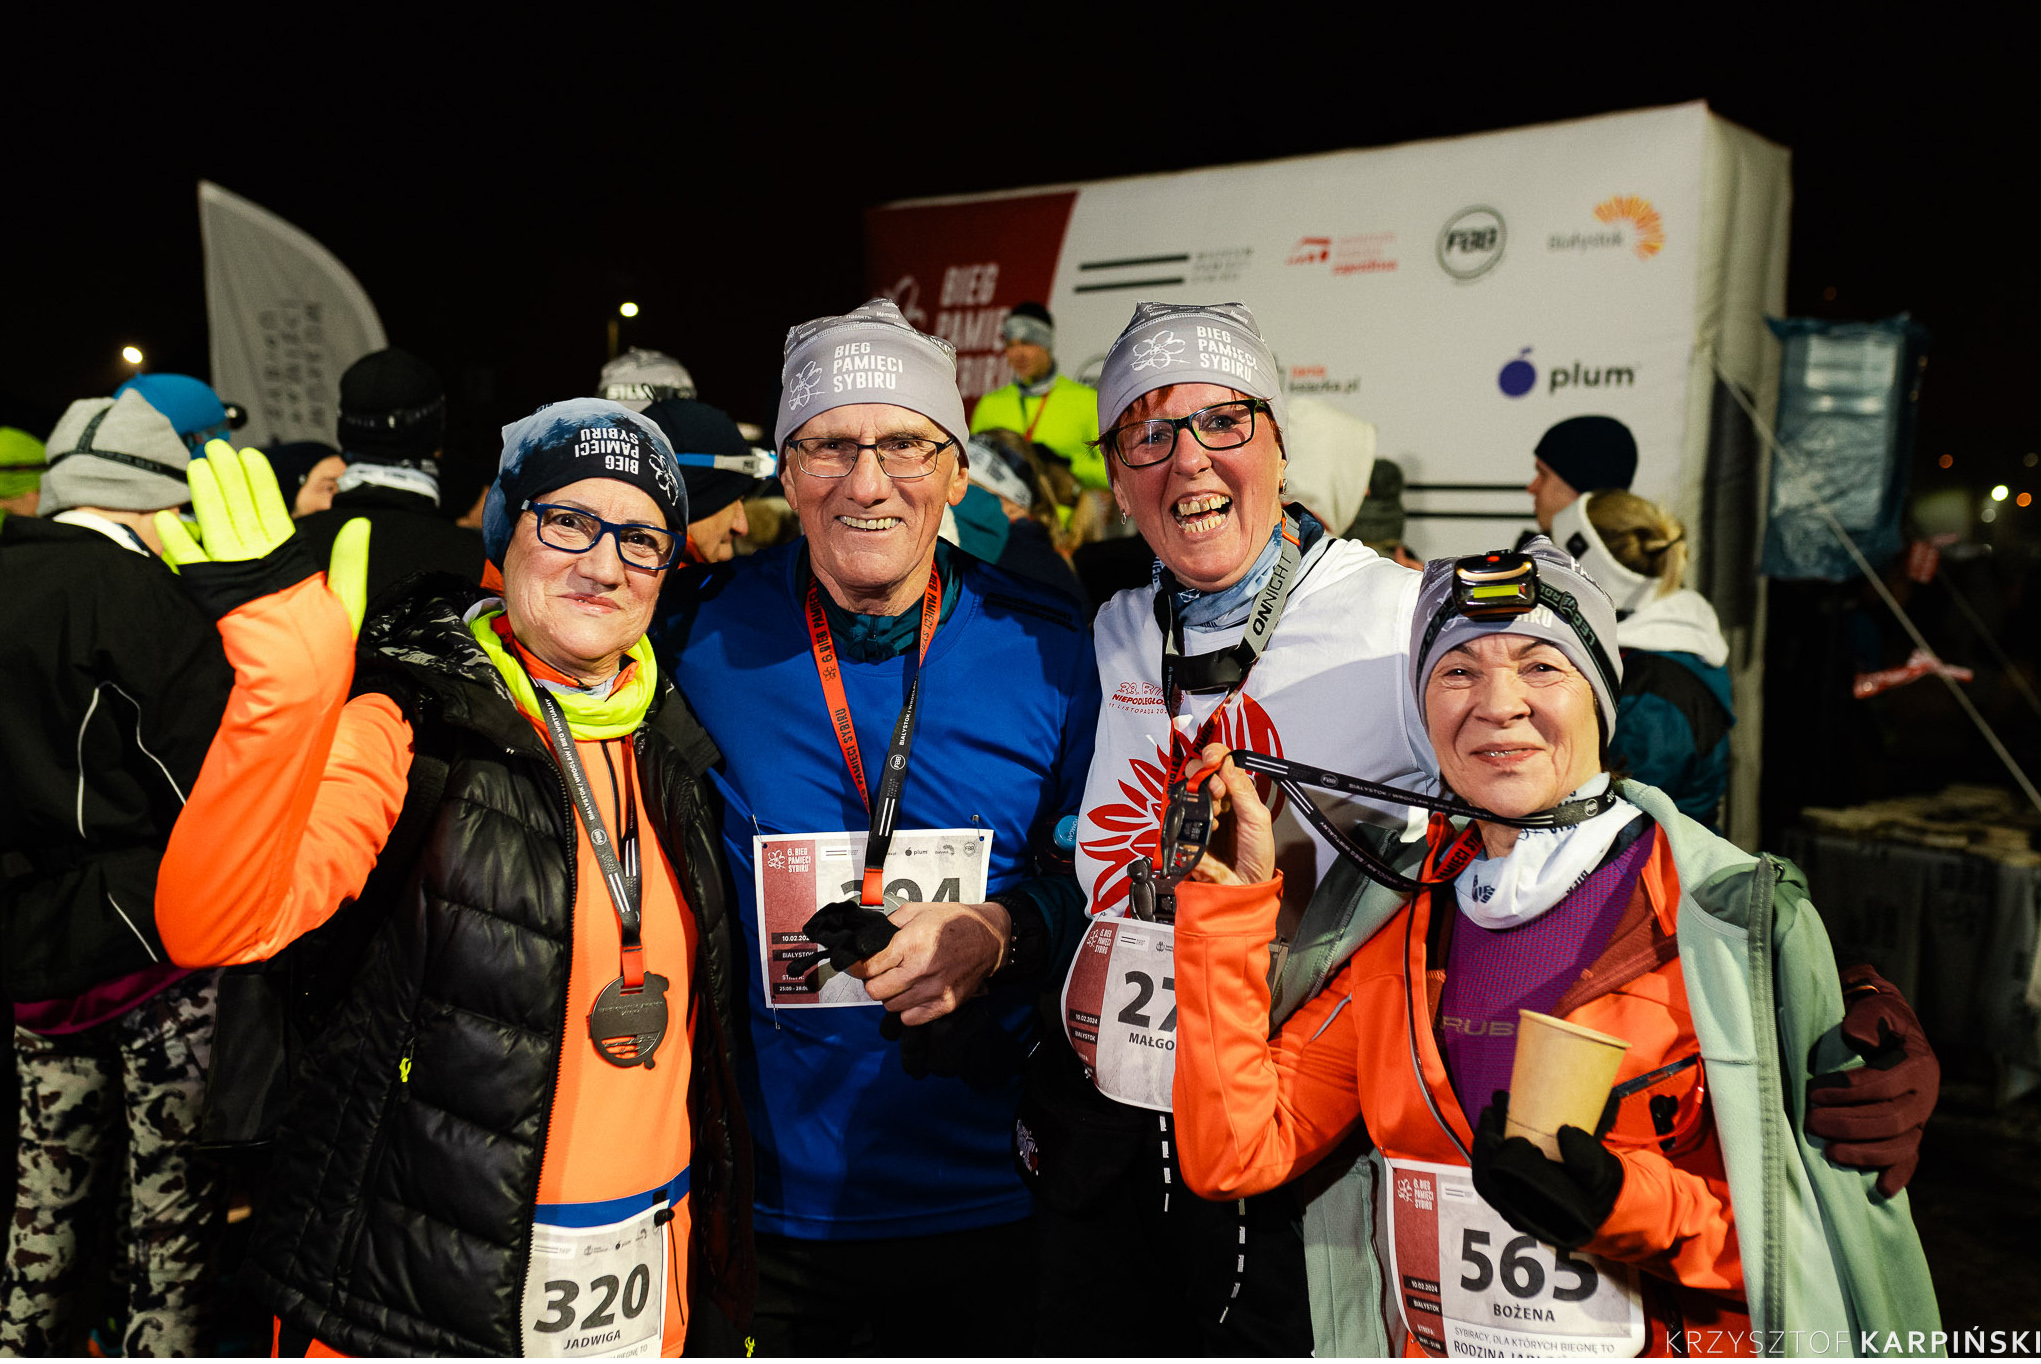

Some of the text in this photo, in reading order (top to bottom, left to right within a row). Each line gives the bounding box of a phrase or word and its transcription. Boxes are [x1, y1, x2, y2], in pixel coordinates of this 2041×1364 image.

[940, 264, 998, 307] BIEG
[1196, 325, 1232, 343] BIEG
[834, 342, 871, 358] BIEG
[833, 355, 903, 374] PAMIĘCI
[1200, 353, 1252, 382] SYBIRU
[833, 371, 897, 393] SYBIRU
[1548, 357, 1635, 394] plum
[580, 427, 638, 445] SYBIRU
[574, 439, 640, 459] PAMIĘCI
[605, 456, 640, 475] BIEG
[835, 708, 852, 743] SYBIRU
[795, 848, 808, 856] BIEG
[788, 864, 809, 873] SYBIRU
[1118, 970, 1178, 1033] 27
[1129, 1032, 1176, 1051] MAŁGO
[1460, 1228, 1599, 1302] 565
[1411, 1280, 1438, 1293] 10.02.2024
[533, 1263, 650, 1333] 320
[1493, 1303, 1556, 1323] BOŻENA
[564, 1329, 621, 1350] JADWIGA
[1453, 1340, 1505, 1358] RODZINA
[1454, 1327, 1615, 1354] SYBIRACY, DLA KTÓRYCH BIEGNĘ TO
